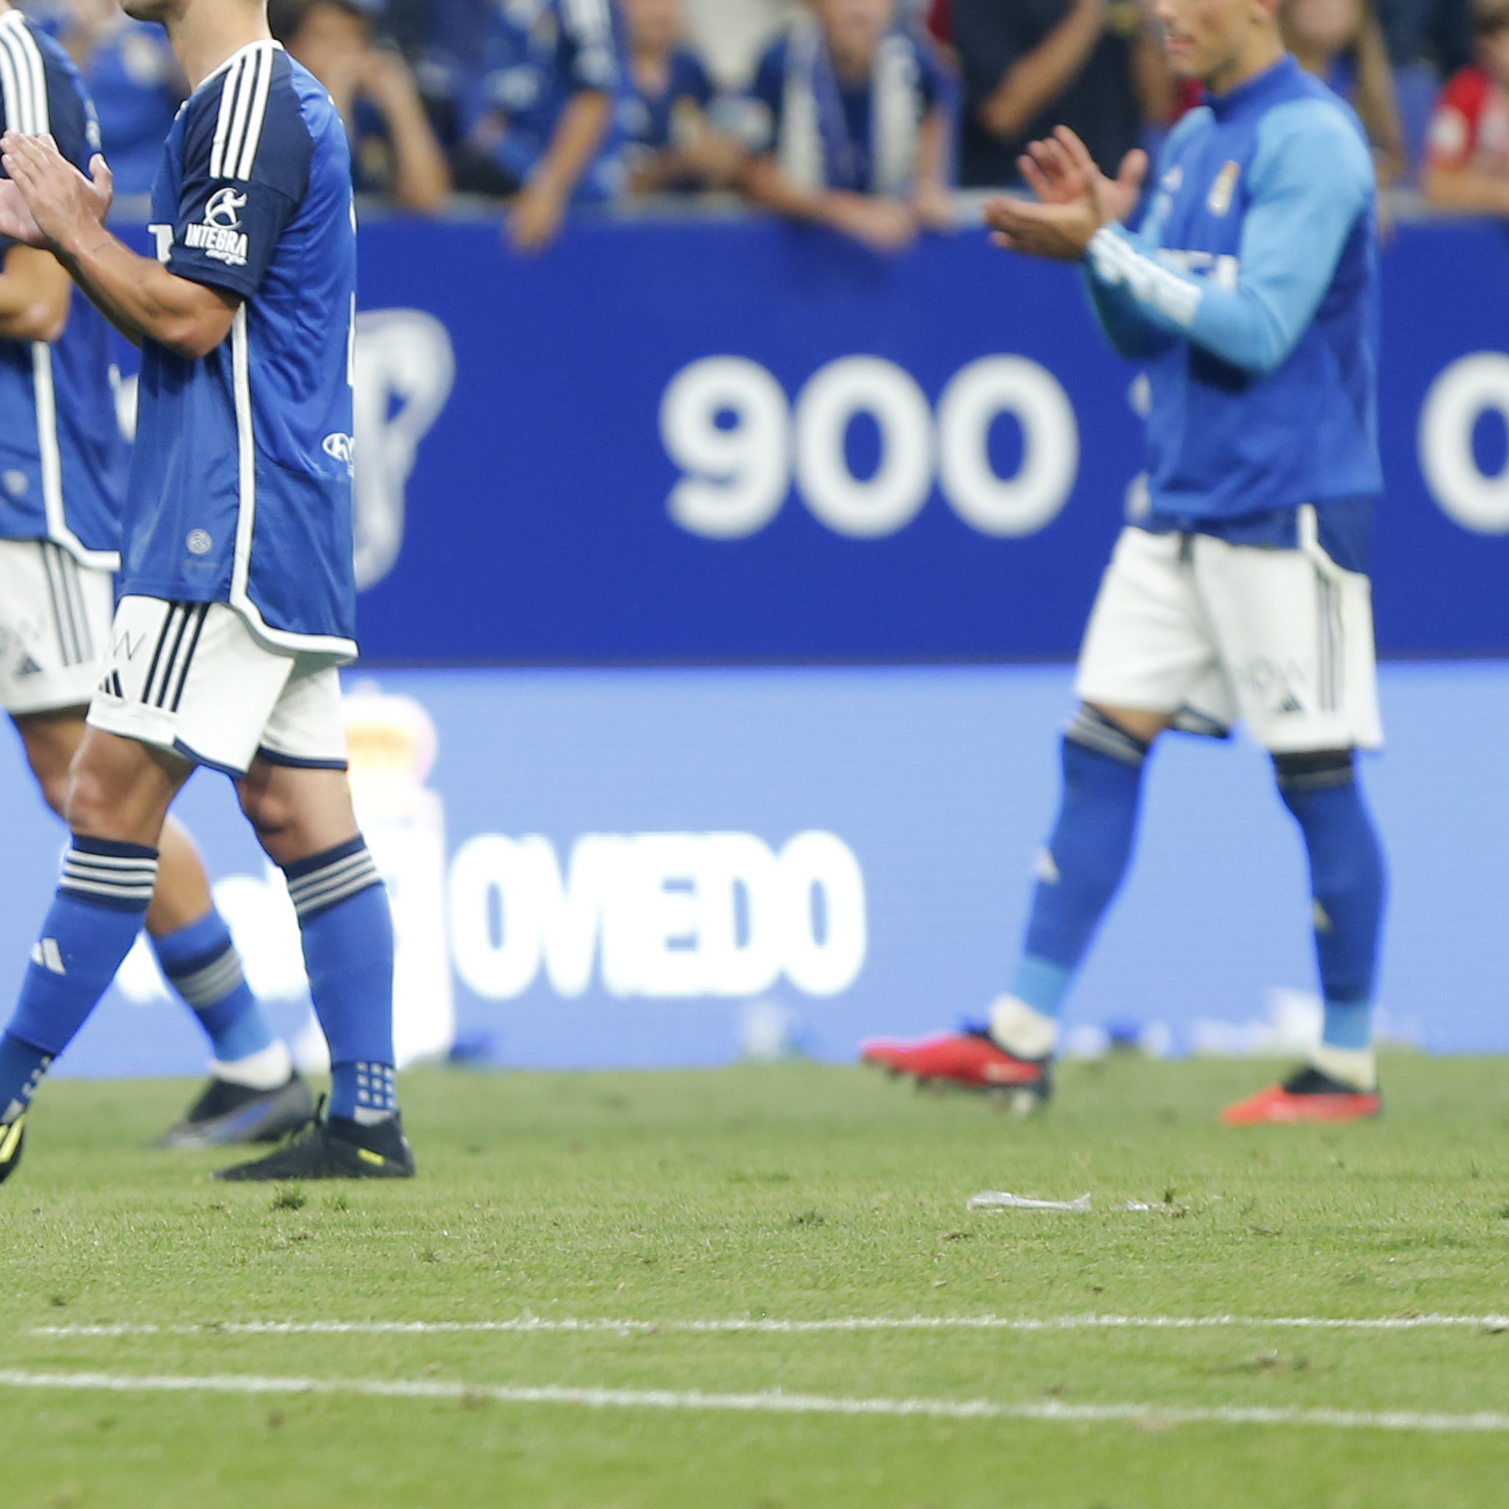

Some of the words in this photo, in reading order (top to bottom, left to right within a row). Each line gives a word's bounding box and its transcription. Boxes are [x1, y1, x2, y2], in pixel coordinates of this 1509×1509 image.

[184, 223, 248, 259] INTEGRA
[660, 353, 1079, 539] 900
[448, 829, 867, 1000] OVIEDO
